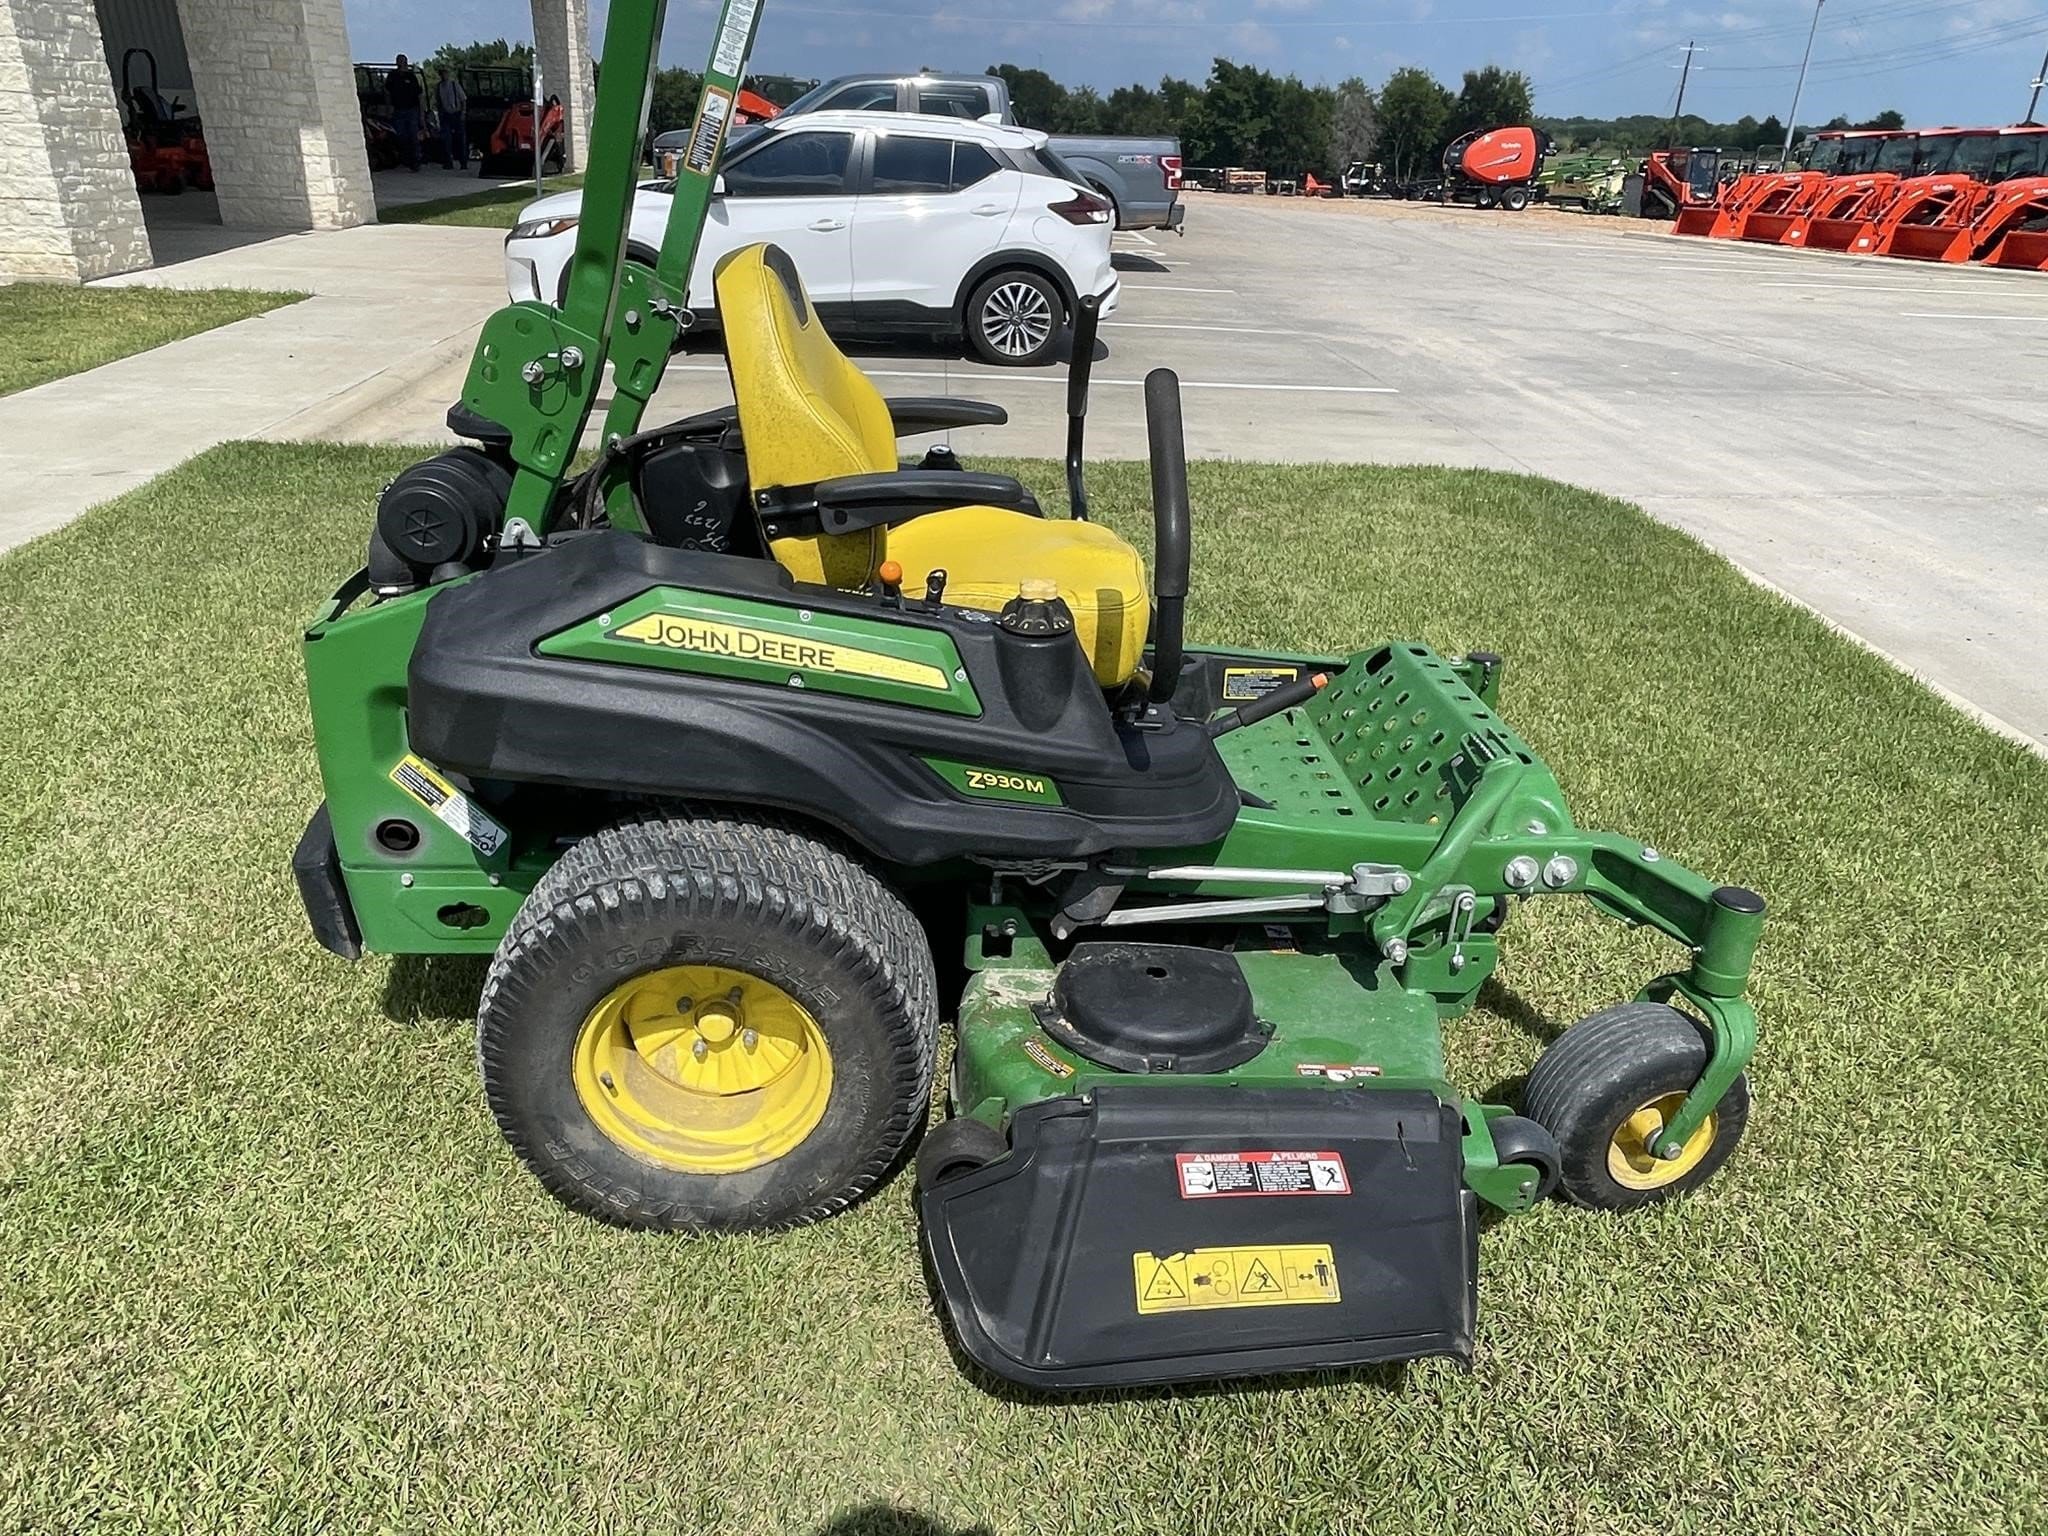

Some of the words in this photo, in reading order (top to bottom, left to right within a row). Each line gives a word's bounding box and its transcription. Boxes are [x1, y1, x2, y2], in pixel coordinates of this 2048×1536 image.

[648, 619, 729, 651] JOHN
[738, 631, 835, 668] DEERE
[965, 770, 1044, 793] Z930M
[604, 930, 840, 1007] CARLISLE
[1204, 1154, 1240, 1162] DANGER
[1280, 1152, 1319, 1161] PELIGRO
